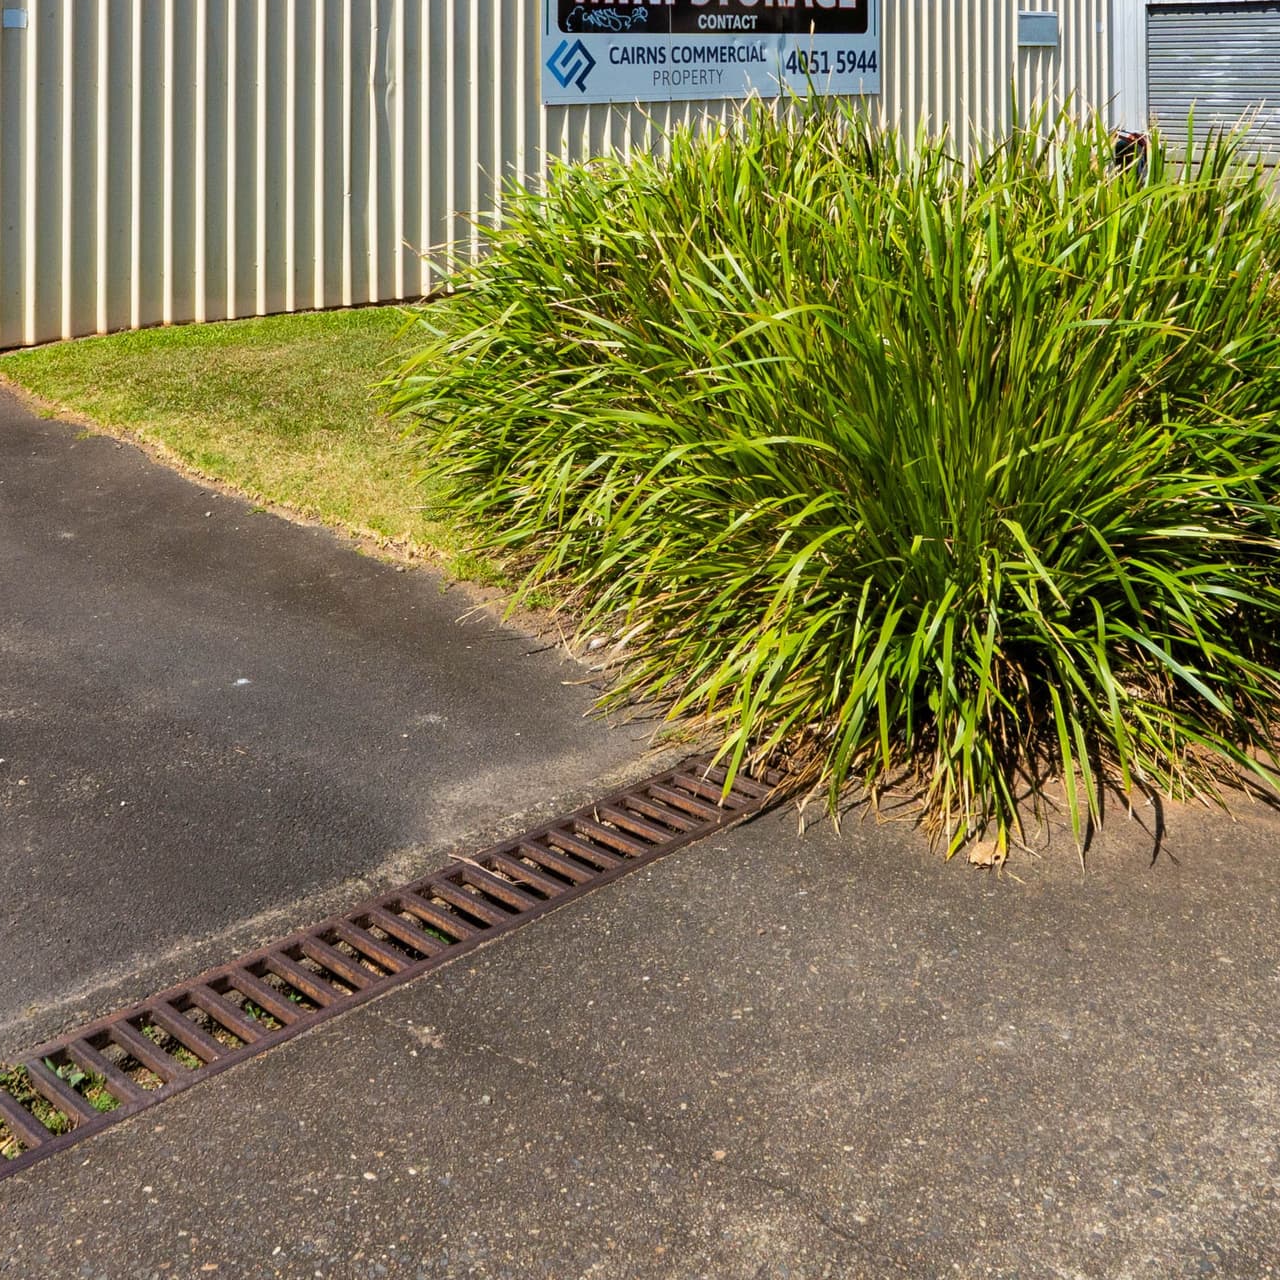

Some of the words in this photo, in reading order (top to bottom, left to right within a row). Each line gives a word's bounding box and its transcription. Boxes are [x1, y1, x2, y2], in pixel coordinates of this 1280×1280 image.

[698, 14, 758, 30] CONTACT
[609, 46, 666, 65] CAIRNS
[671, 45, 767, 64] COMMERCIAL
[786, 50, 830, 74] 4051
[836, 49, 877, 74] 5944
[653, 69, 724, 86] PROPERTY
